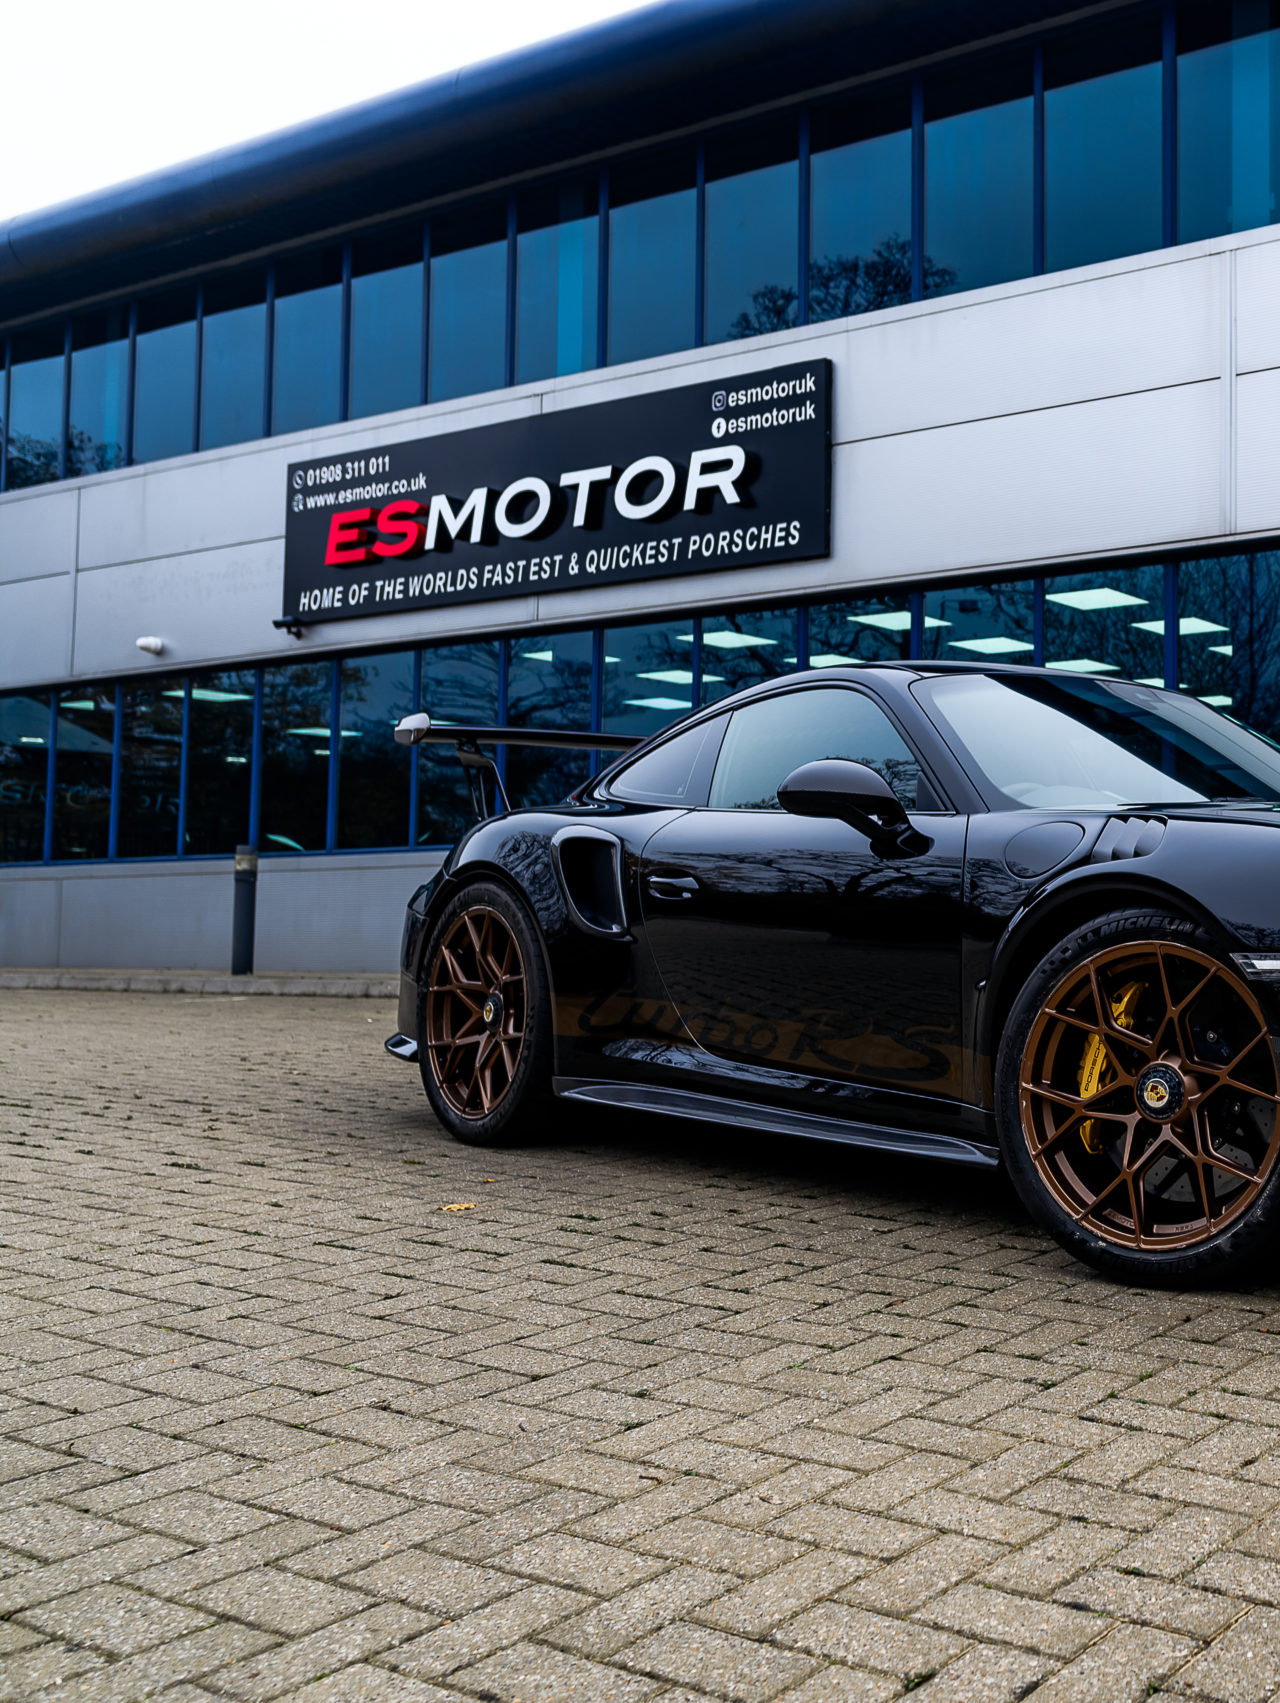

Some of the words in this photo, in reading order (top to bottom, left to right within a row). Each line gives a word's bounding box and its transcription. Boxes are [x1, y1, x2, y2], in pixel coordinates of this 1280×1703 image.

[727, 372, 816, 407] esmotoruk
[727, 400, 816, 434] esmotoruk
[306, 463, 343, 487] 01908
[345, 459, 366, 480] 311
[368, 454, 391, 475] 011
[305, 472, 427, 509] www.esmotor.co.uk
[324, 444, 746, 566] ESMOTOR
[299, 586, 343, 612] HOME
[348, 582, 370, 606] OF
[375, 577, 405, 602] THE
[408, 567, 479, 598] WORLDS
[482, 555, 564, 588] FASTEST
[568, 552, 579, 576] &
[585, 537, 683, 575] QUICKEST
[687, 520, 801, 560] PORSCHES
[1100, 916, 1196, 937] MICHELIN
[1084, 1041, 1102, 1092] PORSCH
